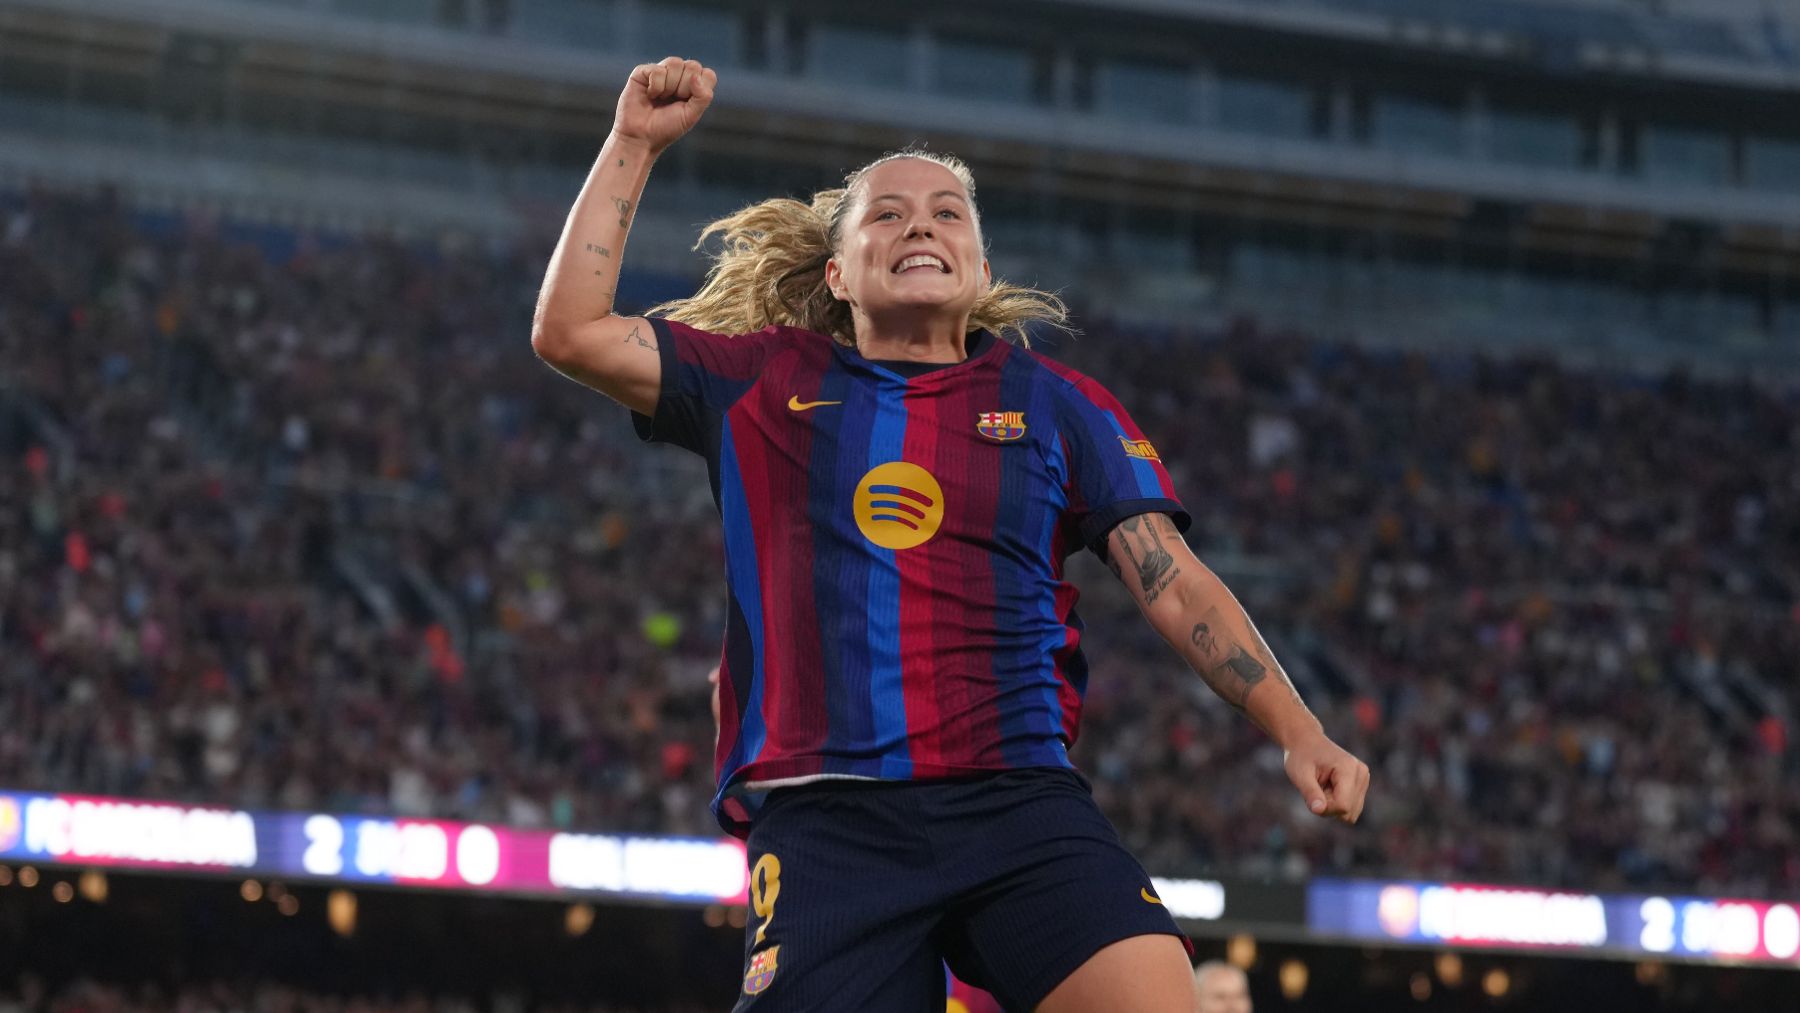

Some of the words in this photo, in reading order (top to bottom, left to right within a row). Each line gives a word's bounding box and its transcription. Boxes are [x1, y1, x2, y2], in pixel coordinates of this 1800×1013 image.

[304, 814, 343, 875] 2
[752, 853, 781, 946] 9
[1640, 897, 1675, 952] 2
